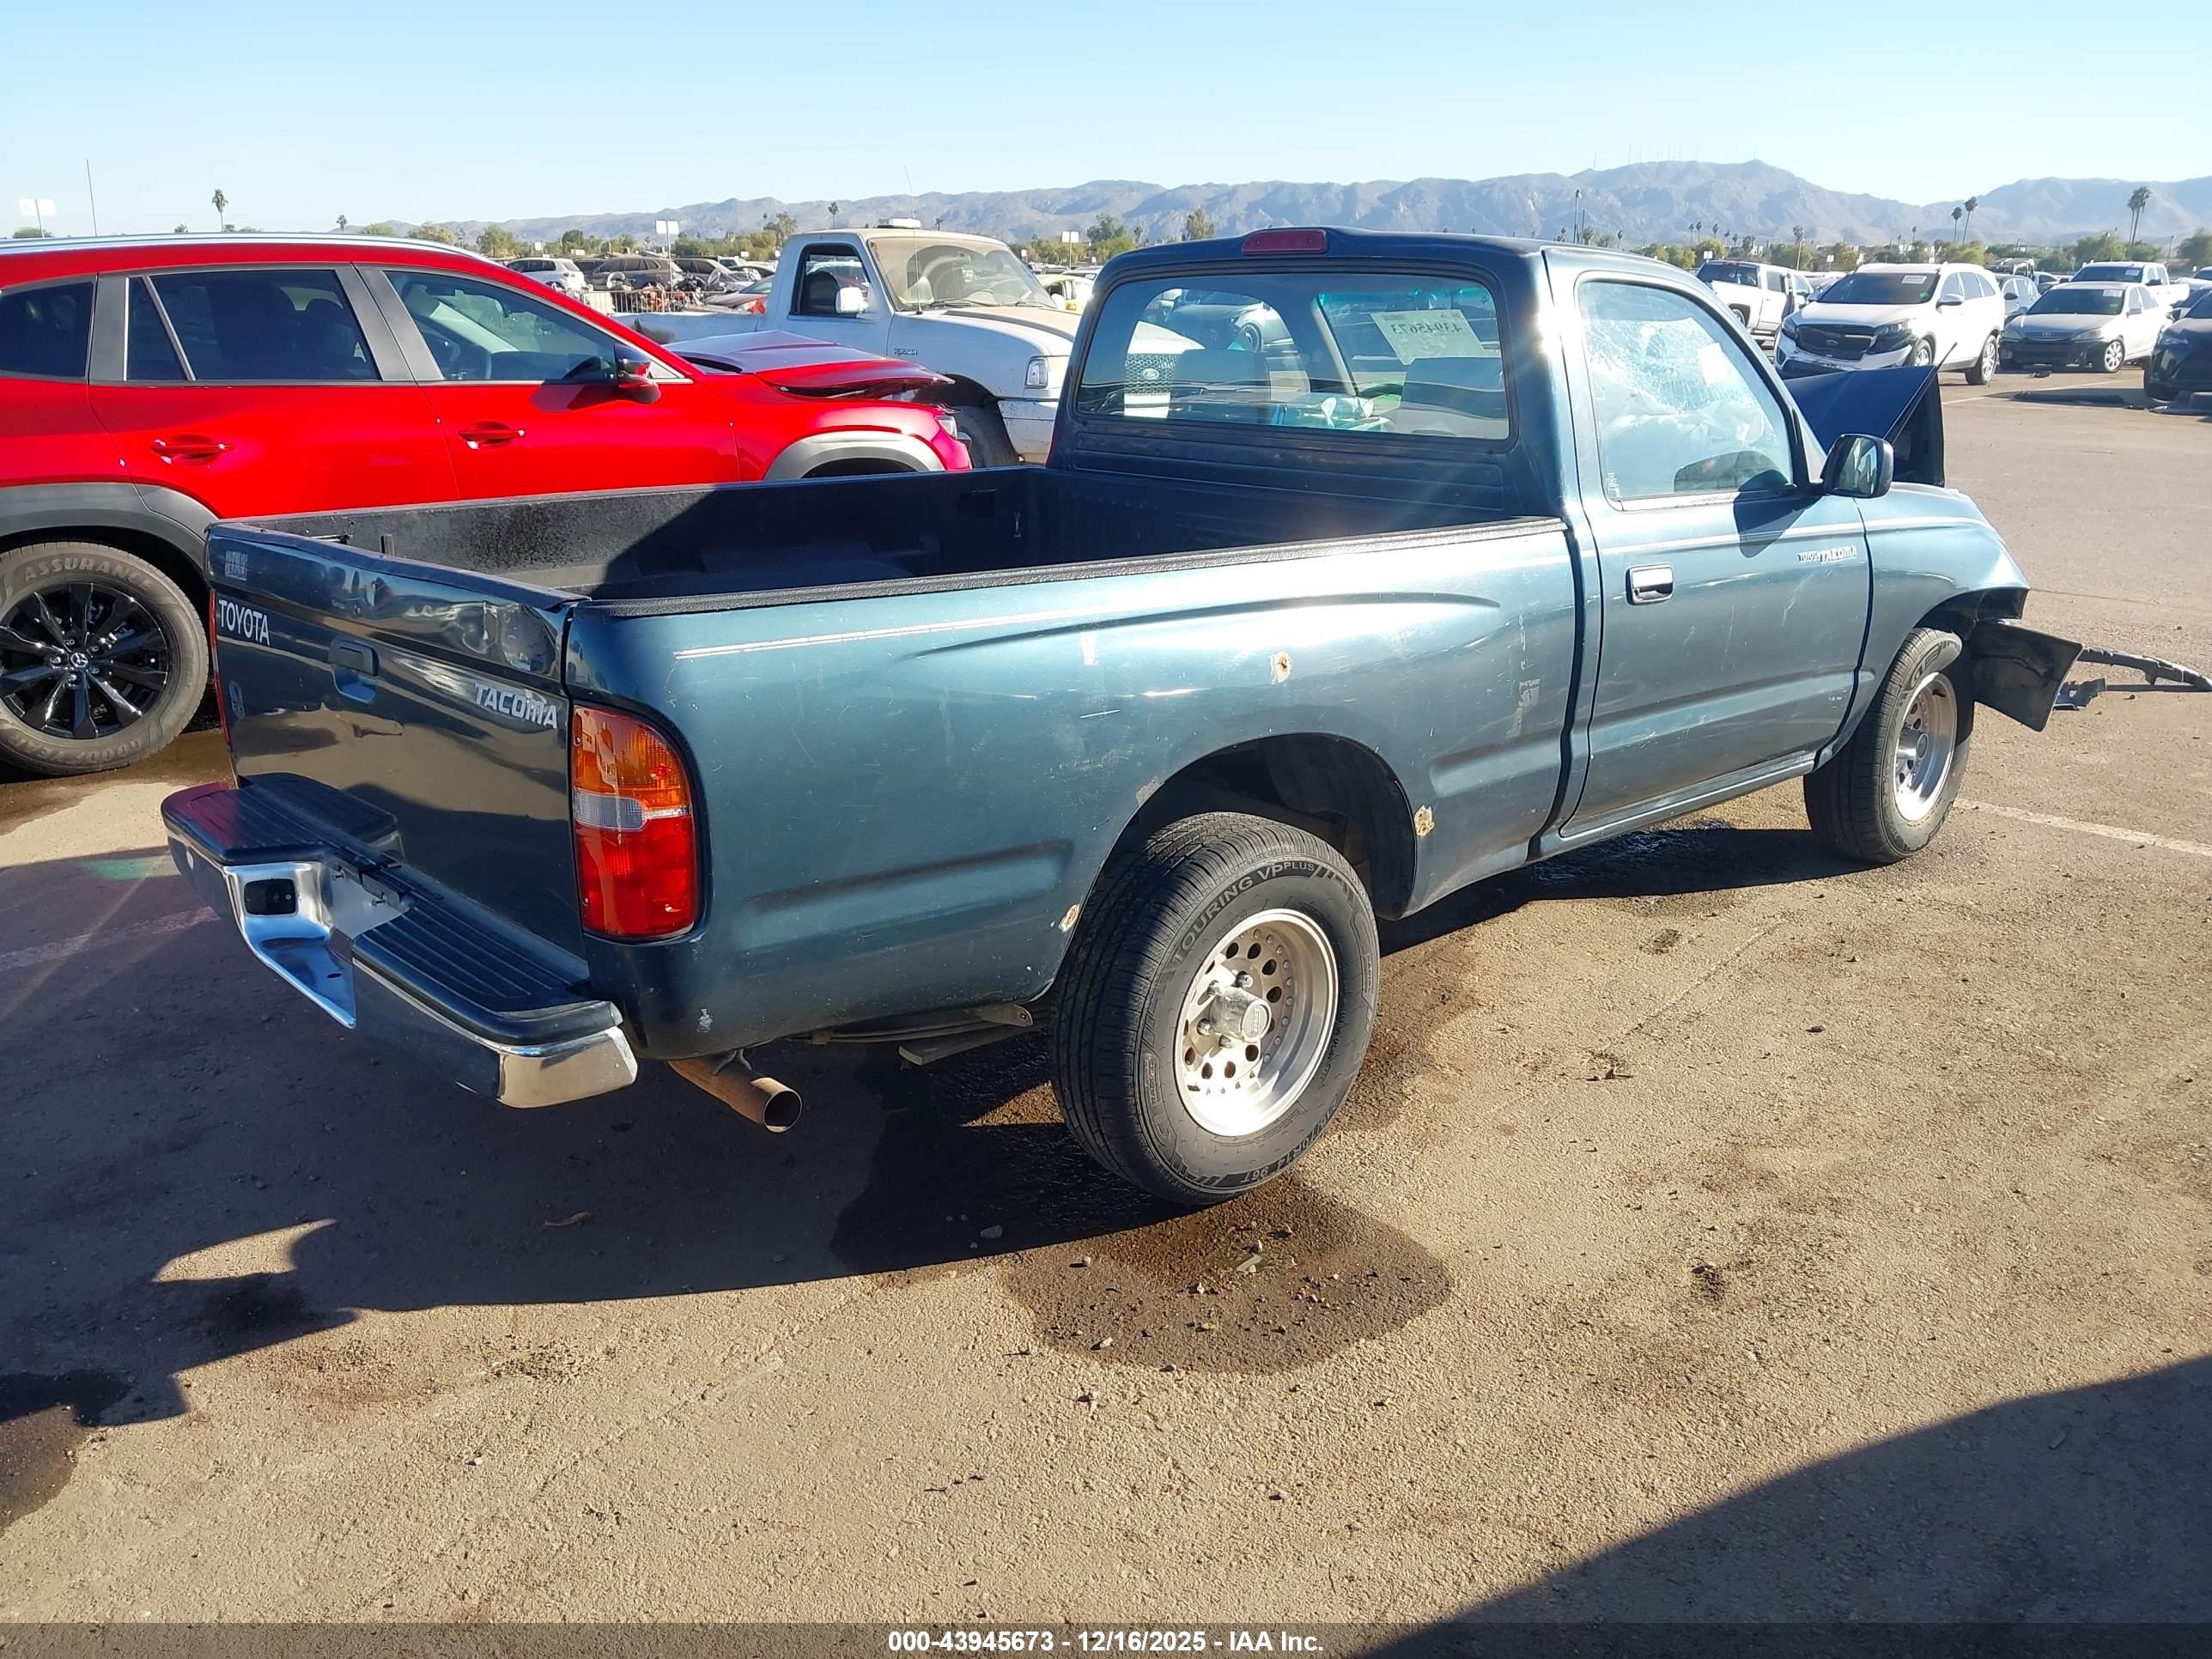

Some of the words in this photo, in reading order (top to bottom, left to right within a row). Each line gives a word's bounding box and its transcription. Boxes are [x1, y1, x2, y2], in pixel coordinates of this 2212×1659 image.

[25, 558, 153, 591] ASSURANCE
[219, 599, 270, 646] TOYOTA
[475, 683, 557, 729] TACOMA
[1171, 876, 1254, 963] TOURING
[1240, 1166, 1269, 1183] 96T
